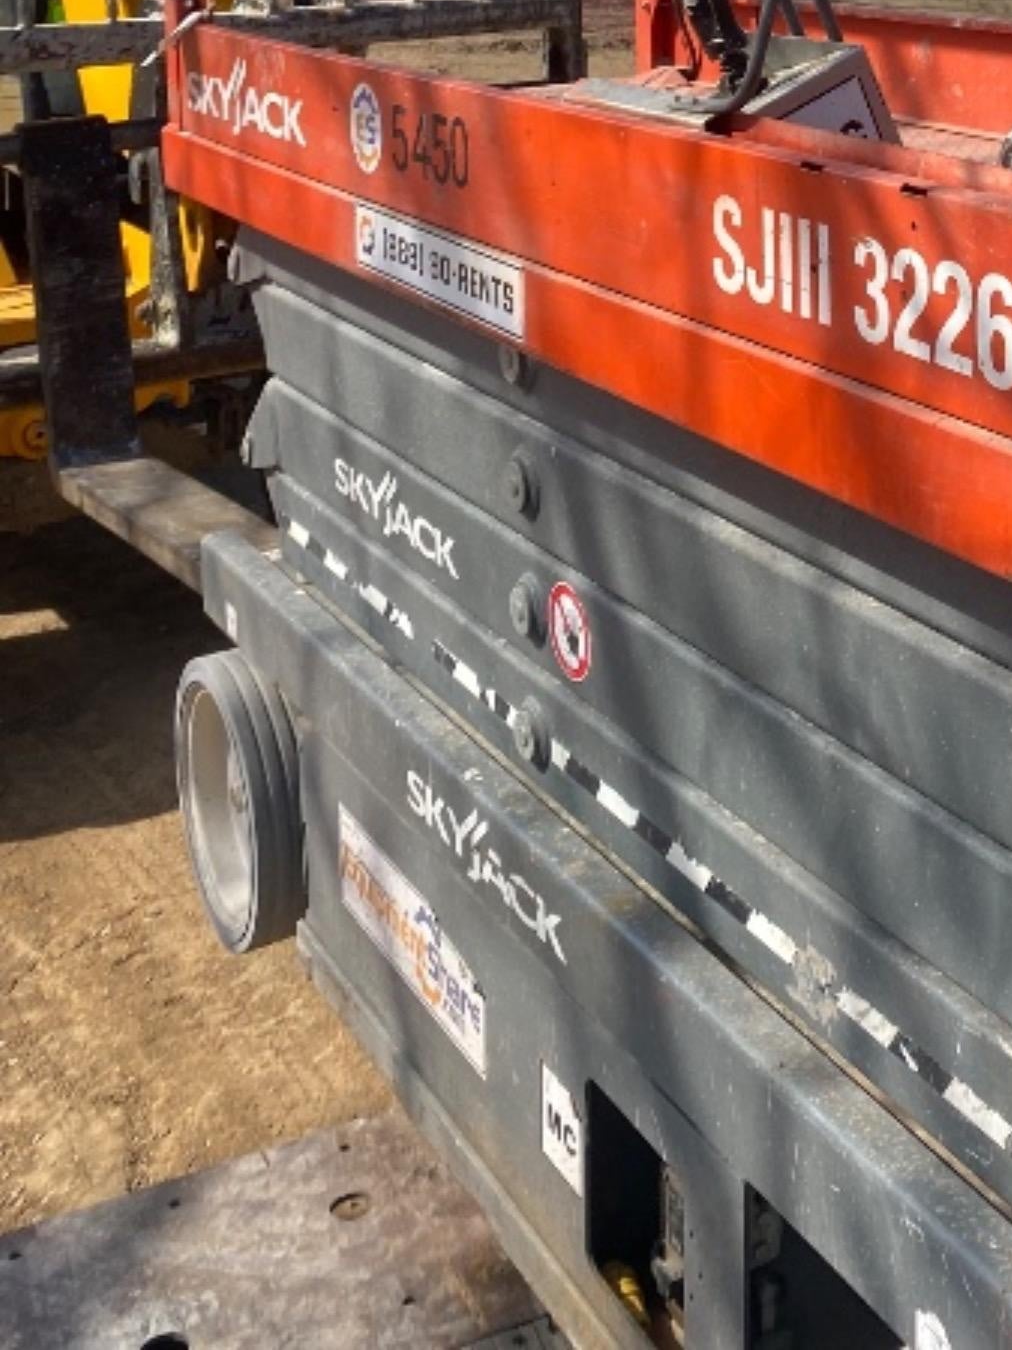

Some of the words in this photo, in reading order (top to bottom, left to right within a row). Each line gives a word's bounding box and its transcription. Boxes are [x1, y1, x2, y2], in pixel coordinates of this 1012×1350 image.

[187, 56, 307, 147] SKYJACK
[391, 104, 469, 189] 5450
[712, 194, 832, 326] SJIII
[334, 457, 460, 580] SKYJACK
[406, 769, 569, 966] SKYJACK
